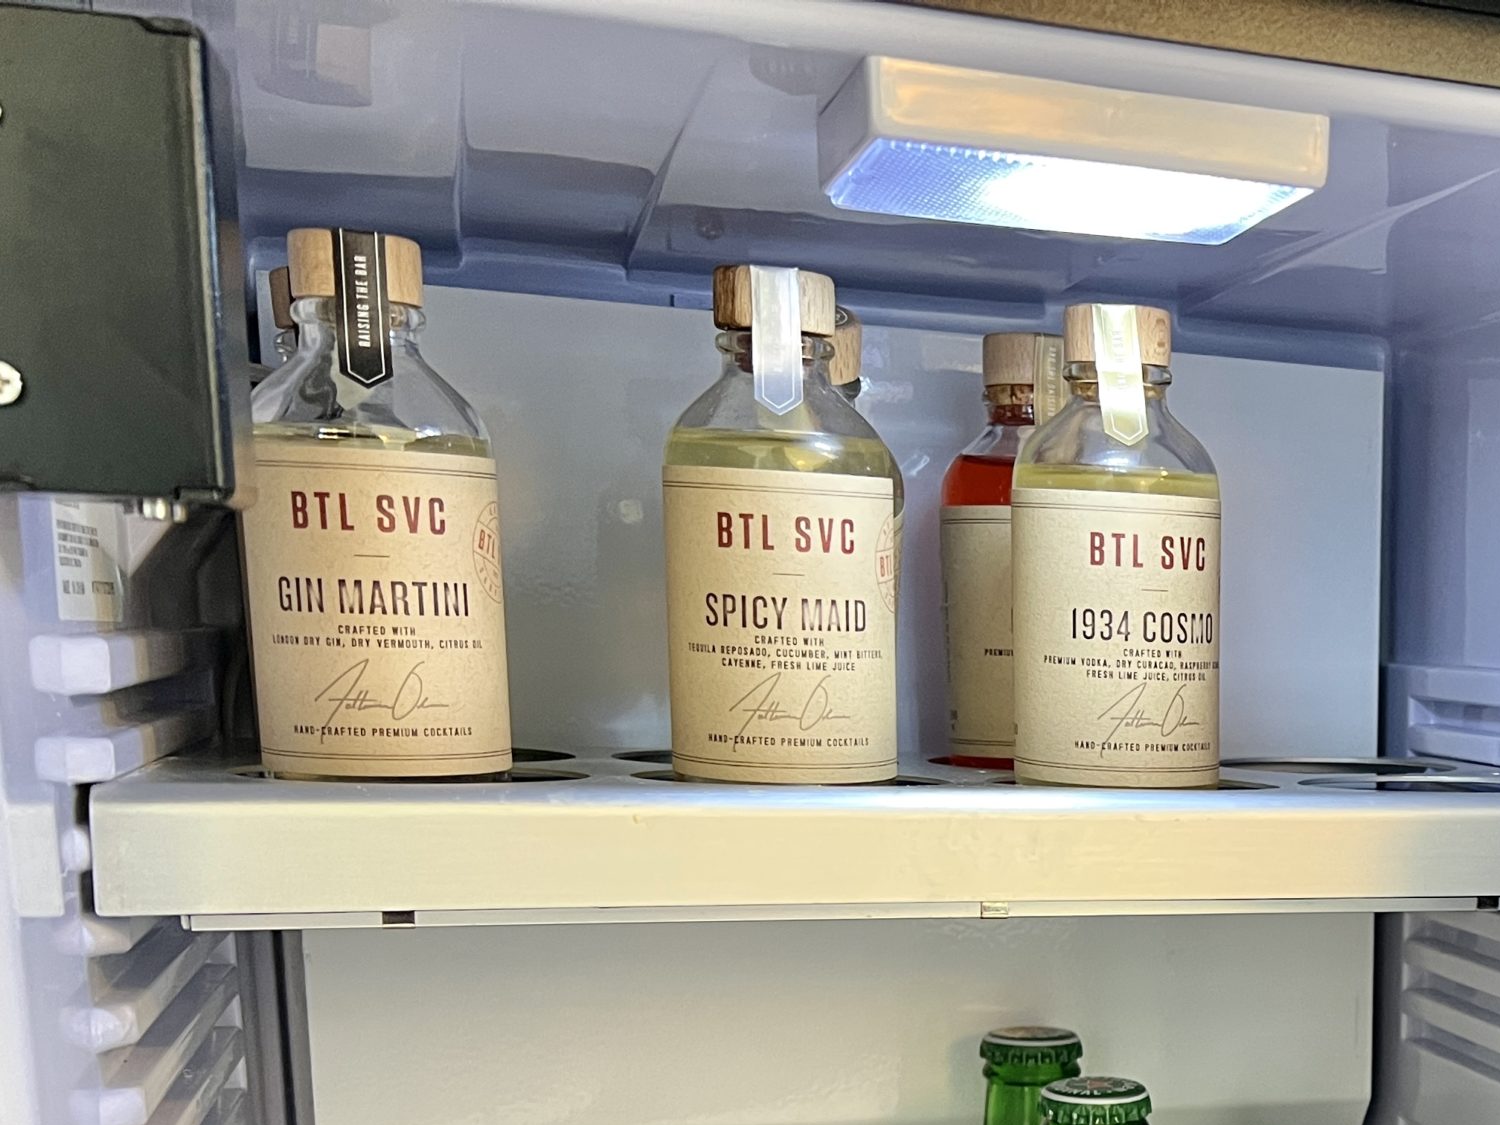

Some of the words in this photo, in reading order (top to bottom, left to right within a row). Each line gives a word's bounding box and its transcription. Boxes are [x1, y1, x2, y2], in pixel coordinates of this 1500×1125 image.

[353, 255, 368, 276] BAR
[355, 280, 369, 300] THE
[356, 304, 371, 348] RAISING
[291, 491, 355, 531] BTL
[376, 494, 446, 535] SVC
[717, 512, 774, 551] BTL
[795, 516, 855, 554] SVC
[1090, 531, 1143, 568] BTL
[1161, 535, 1205, 571] SVC
[278, 576, 324, 613] GIN
[338, 578, 469, 617] MARTINI
[705, 592, 788, 630] SPICY
[801, 598, 867, 632] MAID
[338, 624, 386, 636] CRAFTED
[392, 626, 416, 636] WITH
[1072, 607, 1131, 641] 1934
[1143, 611, 1213, 644] COSMO
[272, 634, 300, 646] LONDON
[303, 635, 320, 646] DRY
[325, 637, 346, 649] GIN,
[351, 638, 370, 648] DRY
[376, 638, 435, 650] VERMOUTH,
[439, 639, 469, 650] CITRUS
[754, 635, 798, 645] CRAFTED
[803, 637, 825, 646] WITH
[688, 642, 716, 653] TEQUILA
[720, 645, 771, 657] REPOSADO,
[776, 648, 830, 659] CUCUMBER,
[834, 650, 852, 659] MINT
[1123, 648, 1161, 658] CRAFTED
[1166, 650, 1182, 658] WITH
[721, 657, 766, 670] CAYENNE,
[771, 660, 801, 670] FRESH
[806, 662, 827, 671] LIME
[832, 662, 856, 671] JUICE
[1043, 655, 1077, 665] PREMIUM
[1081, 657, 1111, 669] VODKA,
[1116, 660, 1133, 669] DRY
[1136, 661, 1176, 671] CURACAO,
[1086, 670, 1114, 680] FRESH
[1118, 671, 1138, 680] LIME
[1142, 672, 1170, 682] JUICE,
[1173, 672, 1196, 681] CITRUS
[294, 725, 367, 738] HAND-CRAFTED
[372, 727, 419, 738] PREMIUM
[423, 727, 472, 737] COCKTAILS
[708, 733, 776, 746] HAND-CRAFTED
[781, 736, 822, 747] PREMIUM
[827, 737, 869, 747] COCKTAILS
[1075, 741, 1140, 752] HAND-CRAFTED
[1145, 742, 1179, 752] PREMIUM
